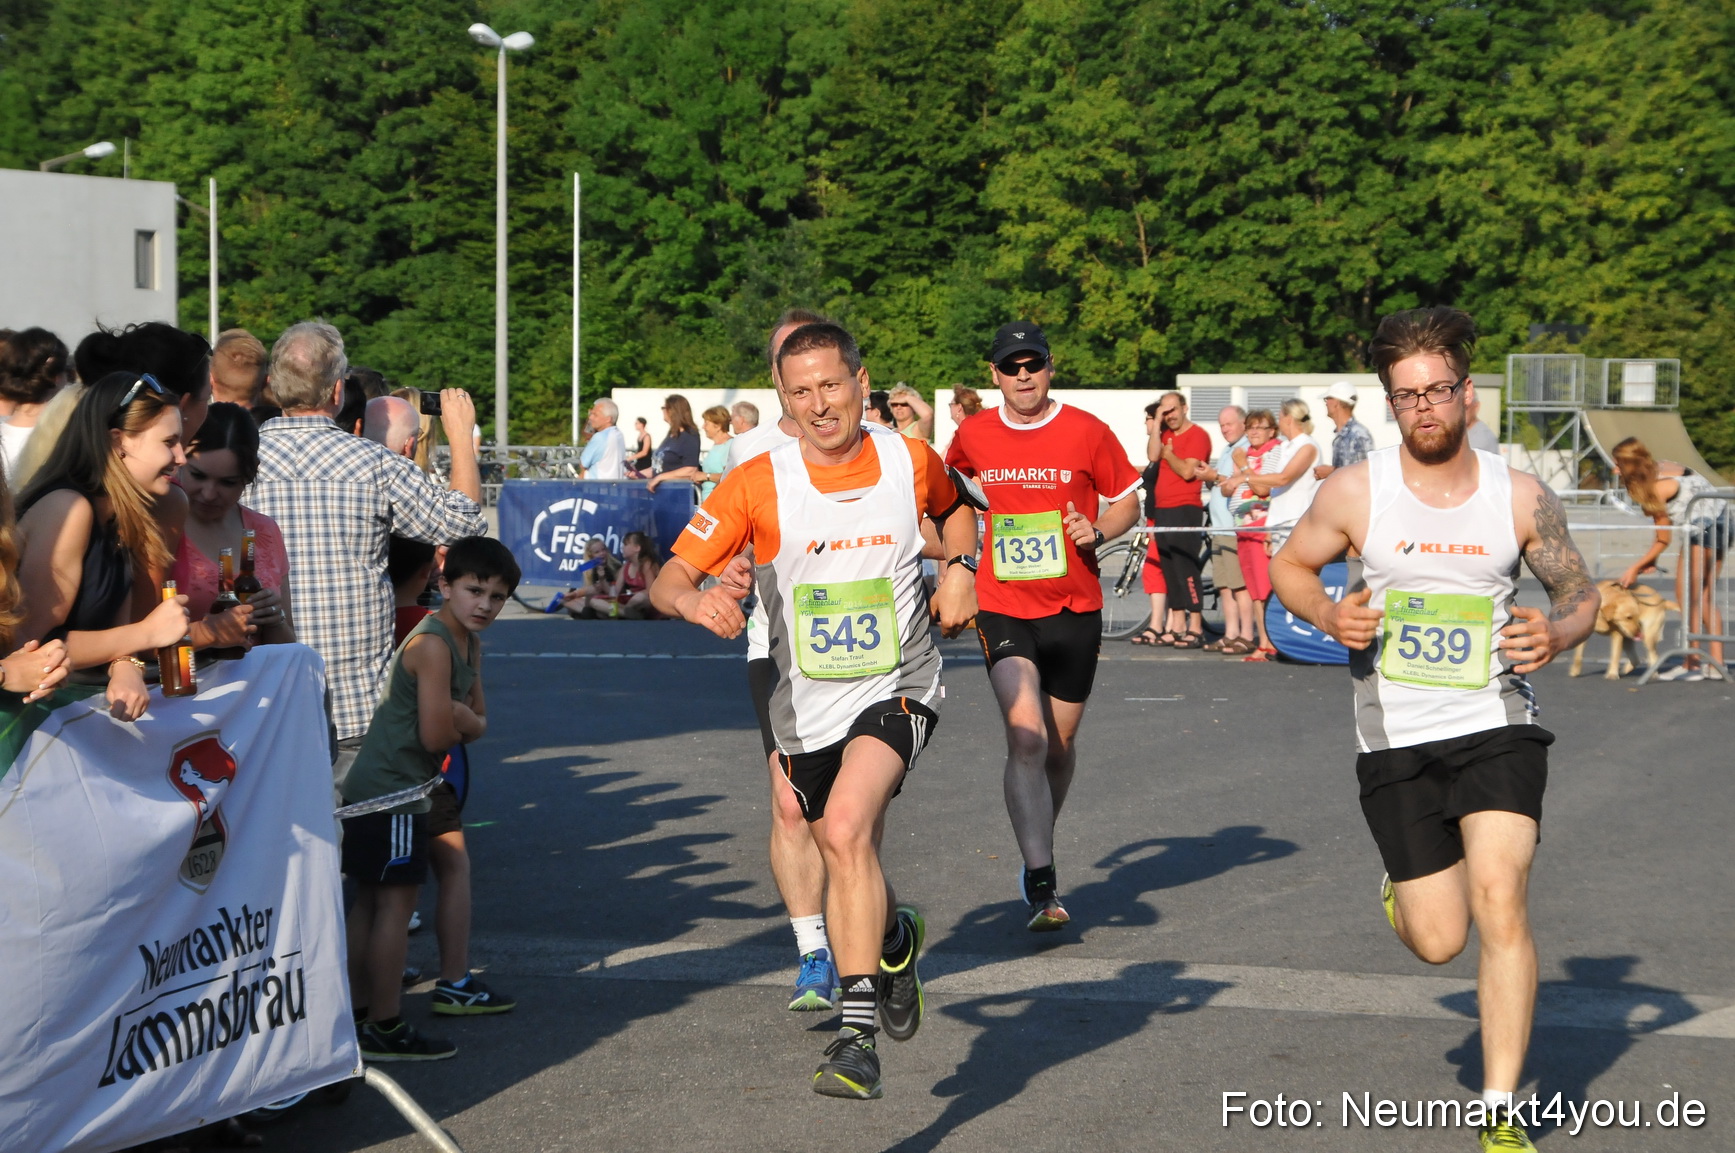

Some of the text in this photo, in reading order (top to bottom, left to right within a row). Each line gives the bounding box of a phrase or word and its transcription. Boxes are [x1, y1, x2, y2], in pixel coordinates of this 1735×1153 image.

[980, 468, 1057, 482] NEUMARKT
[688, 512, 713, 534] BI
[550, 525, 625, 555] Fish
[830, 534, 897, 551] KLEBL
[994, 534, 1058, 564] 1331
[1420, 543, 1490, 556] KLEBL
[809, 613, 881, 654] 543
[1398, 624, 1472, 664] 539
[1402, 669, 1420, 677] KLEBL
[1421, 672, 1447, 680] Dynamics
[1406, 662, 1425, 670] Daniel
[188, 850, 216, 878] 1628
[138, 904, 273, 994] Neumarkter
[97, 956, 306, 1089] Lammsbräu
